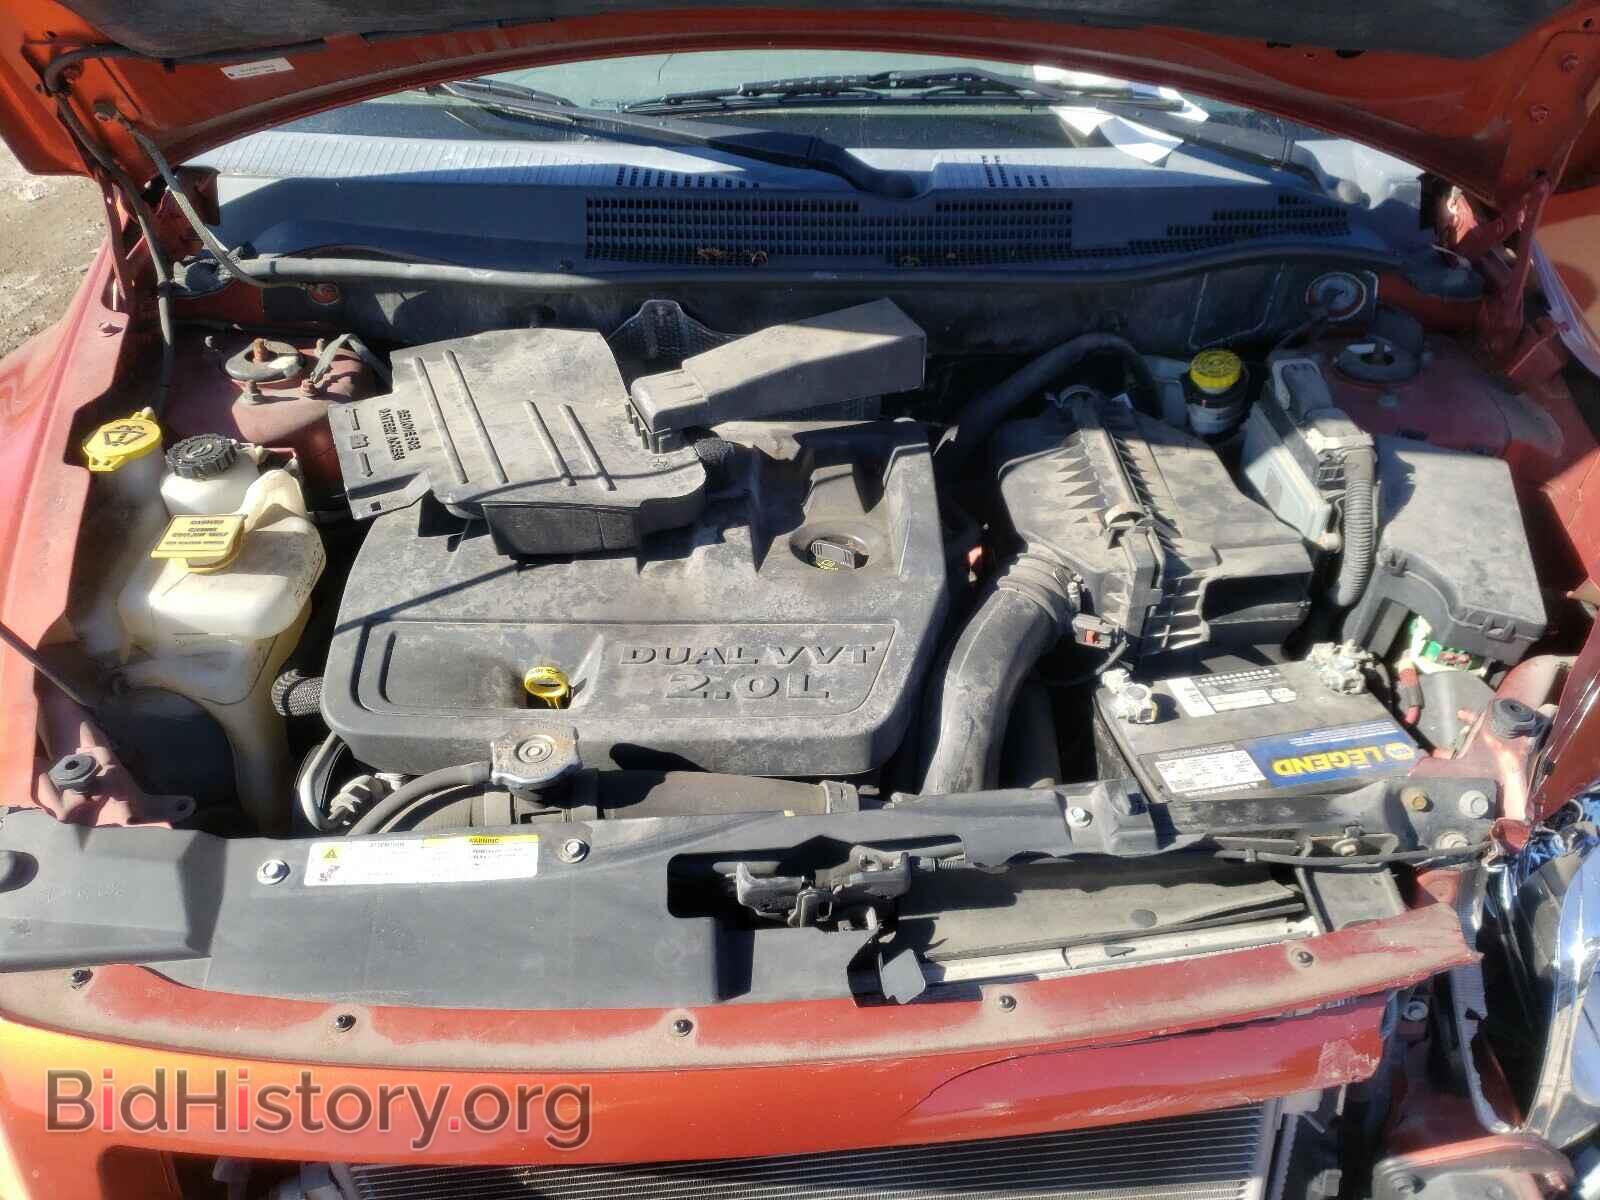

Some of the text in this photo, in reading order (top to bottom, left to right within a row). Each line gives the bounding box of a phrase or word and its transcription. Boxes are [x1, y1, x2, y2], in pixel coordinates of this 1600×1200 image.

[619, 645, 877, 666] DUAL VVT
[664, 673, 830, 700] 2.0L
[1273, 745, 1384, 776] LEGEND
